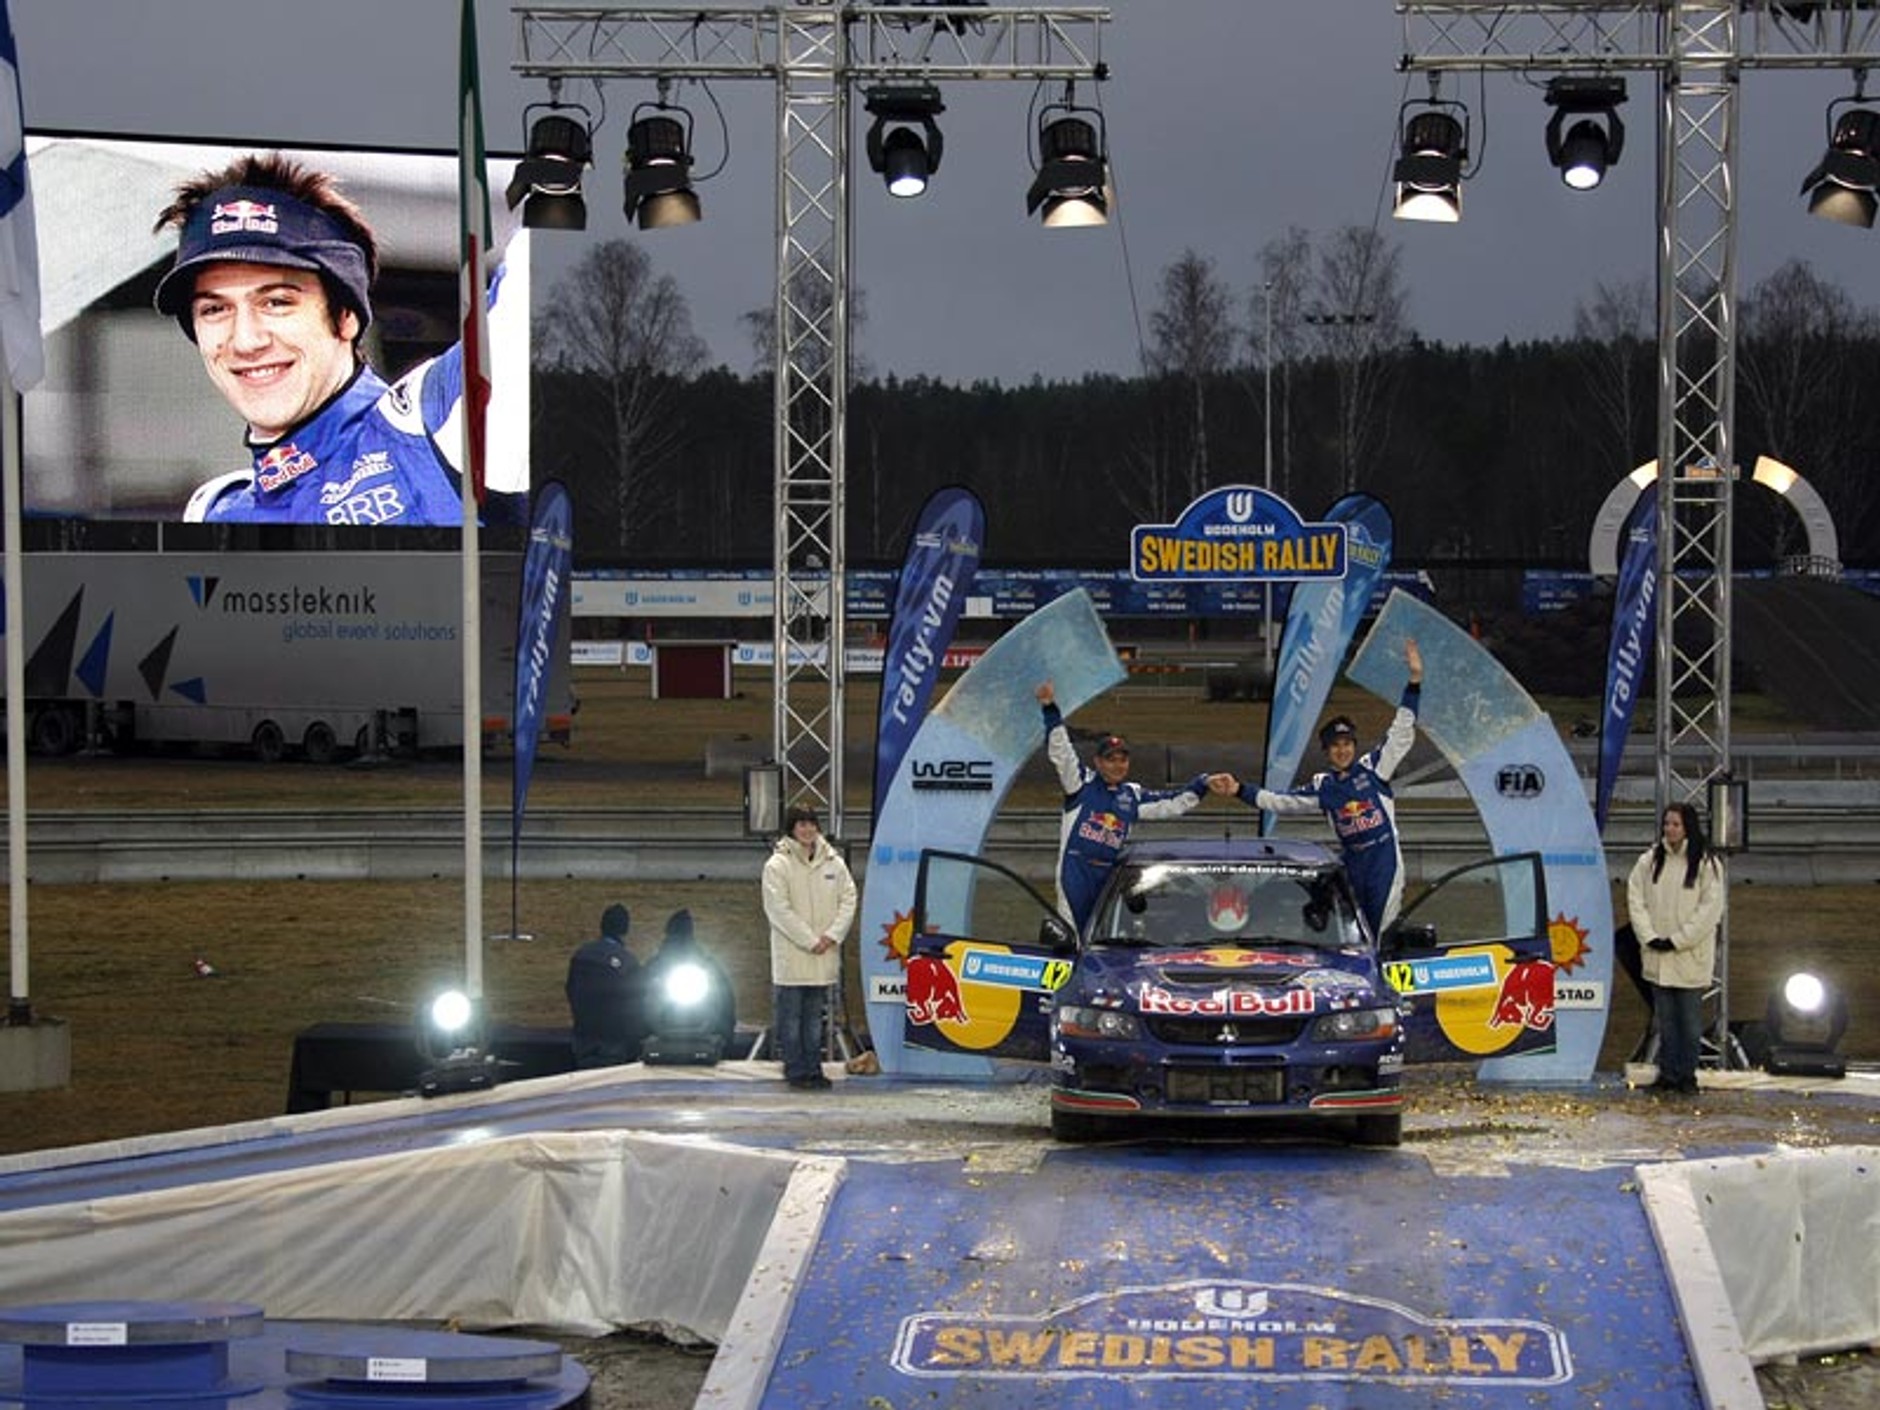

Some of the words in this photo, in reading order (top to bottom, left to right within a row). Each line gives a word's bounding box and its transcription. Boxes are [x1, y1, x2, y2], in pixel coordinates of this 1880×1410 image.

[258, 468, 289, 492] Red
[286, 452, 318, 476] Bull
[1140, 535, 1256, 573] SWEDISH
[1262, 532, 1340, 572] RALLY
[222, 586, 377, 616] massteknik
[281, 620, 333, 643] global
[384, 621, 457, 642] solutions
[912, 760, 993, 779] WRC
[1498, 770, 1540, 793] FIA
[1041, 961, 1073, 991] 42
[1389, 962, 1415, 992] 42
[1140, 981, 1228, 1013] Red
[1229, 985, 1316, 1014] Bull
[930, 1326, 1275, 1368] SWEDISH
[1303, 1332, 1528, 1374] RALLY
